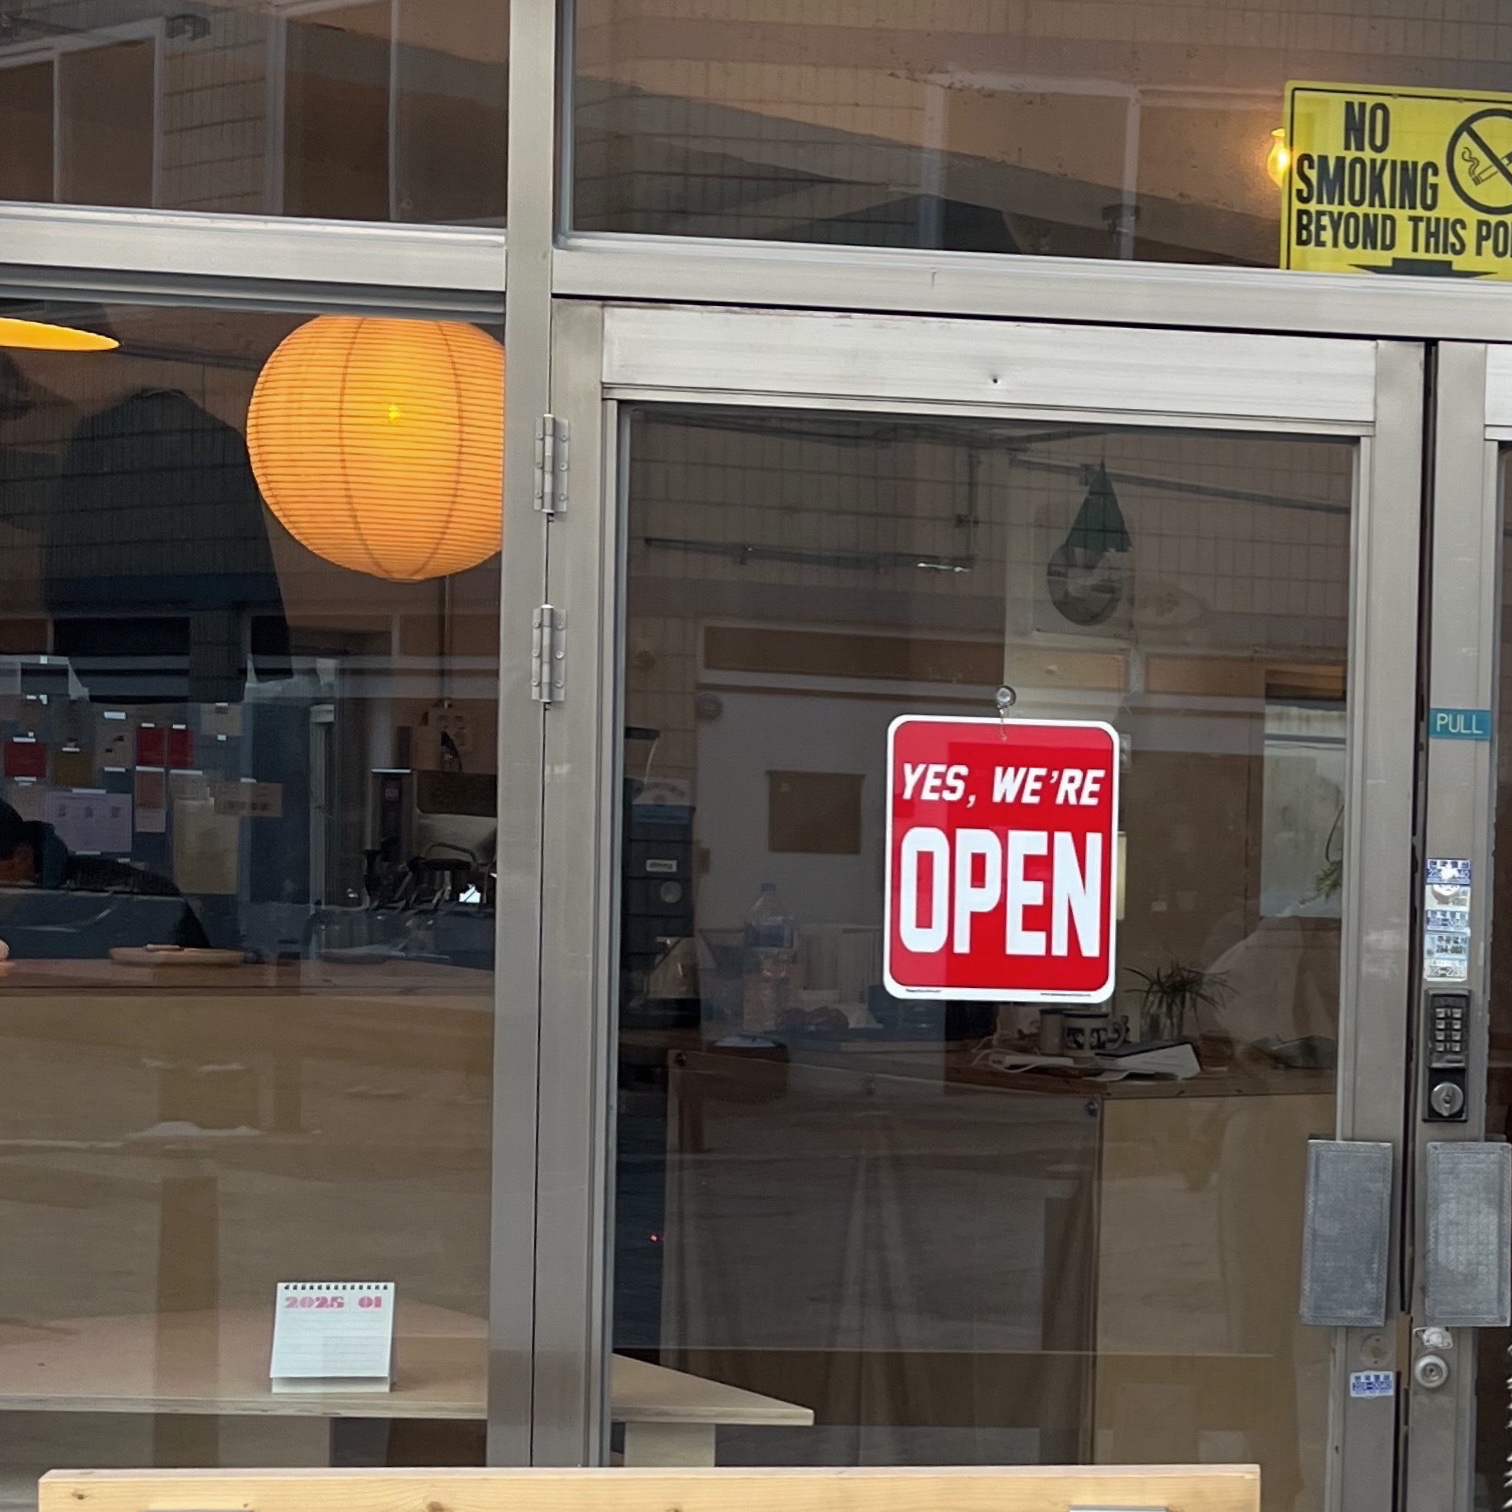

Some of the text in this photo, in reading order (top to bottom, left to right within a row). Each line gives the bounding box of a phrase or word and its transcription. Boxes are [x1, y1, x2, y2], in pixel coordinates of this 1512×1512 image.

[1343, 100, 1391, 154] NO
[1295, 153, 1440, 212] SMOKING
[1295, 208, 1397, 252] BEYOND
[1408, 214, 1467, 256] THIS
[1436, 713, 1483, 735] PULL
[902, 762, 1106, 808] YES, WE'RE
[899, 826, 1103, 959] OPEN
[284, 1295, 345, 1310] 2025
